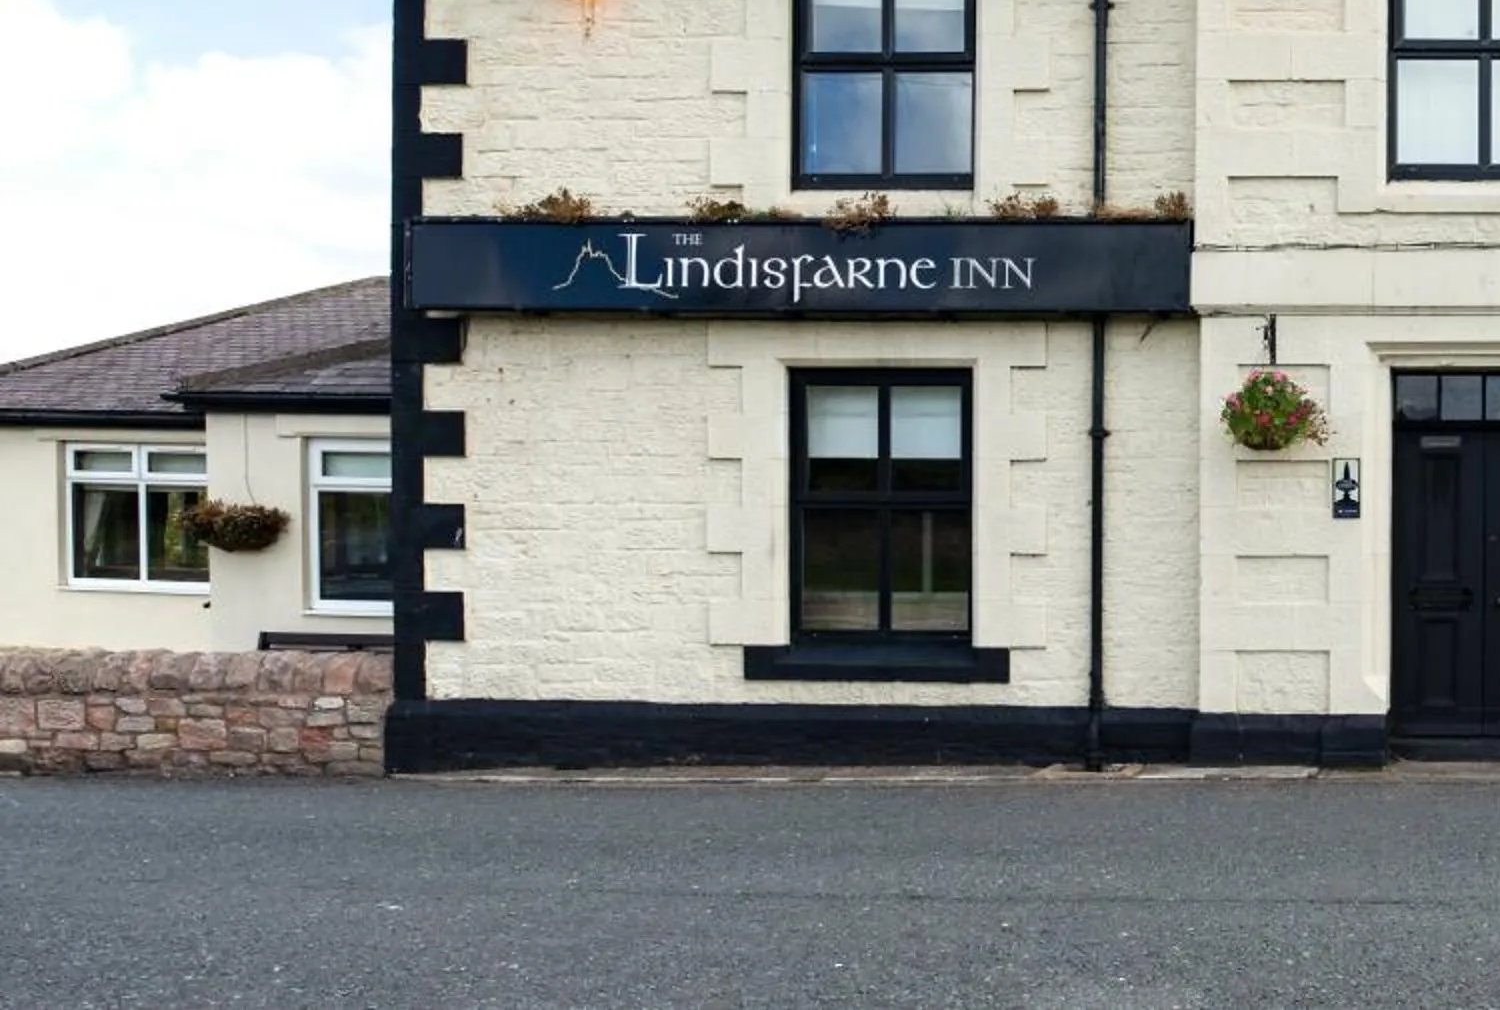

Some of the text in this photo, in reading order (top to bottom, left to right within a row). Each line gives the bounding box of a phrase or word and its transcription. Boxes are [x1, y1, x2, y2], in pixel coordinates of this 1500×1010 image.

[672, 233, 703, 245] THE
[617, 233, 1036, 303] Lindisfarne INN
